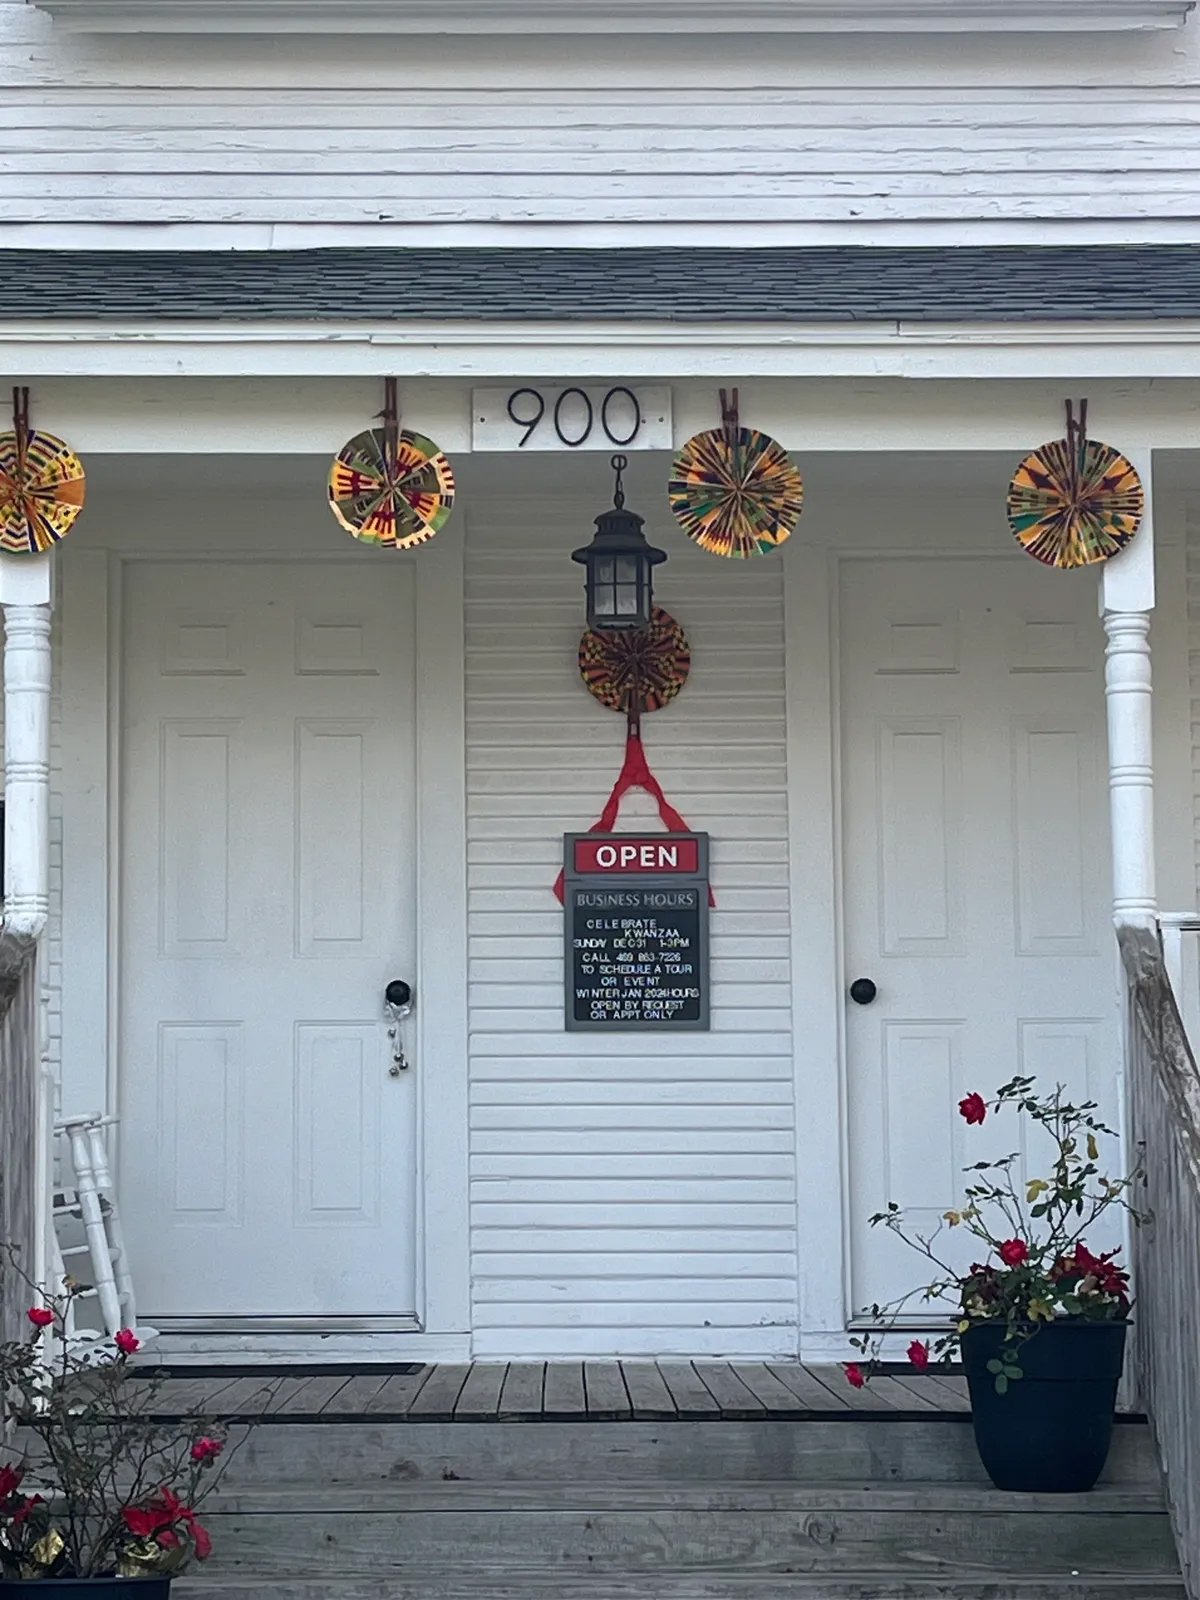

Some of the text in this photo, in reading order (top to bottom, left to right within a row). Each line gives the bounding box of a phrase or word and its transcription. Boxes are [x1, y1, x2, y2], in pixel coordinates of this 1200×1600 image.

[507, 386, 640, 447] 900
[596, 845, 677, 868] OPEN
[577, 893, 694, 906] BUSINESS HOURS
[586, 919, 657, 929] CELEBRATE
[624, 929, 680, 938] KWANZAA
[582, 953, 611, 962] CALL
[581, 964, 693, 974] TO SCHEDULE A TOUR
[601, 977, 660, 986] OR EVENT
[576, 989, 620, 998] WINTER
[621, 989, 642, 998] JAN
[591, 1000, 685, 1010] OPEN BY REQUEST
[590, 1010, 674, 1019] OR APPT ONLY
